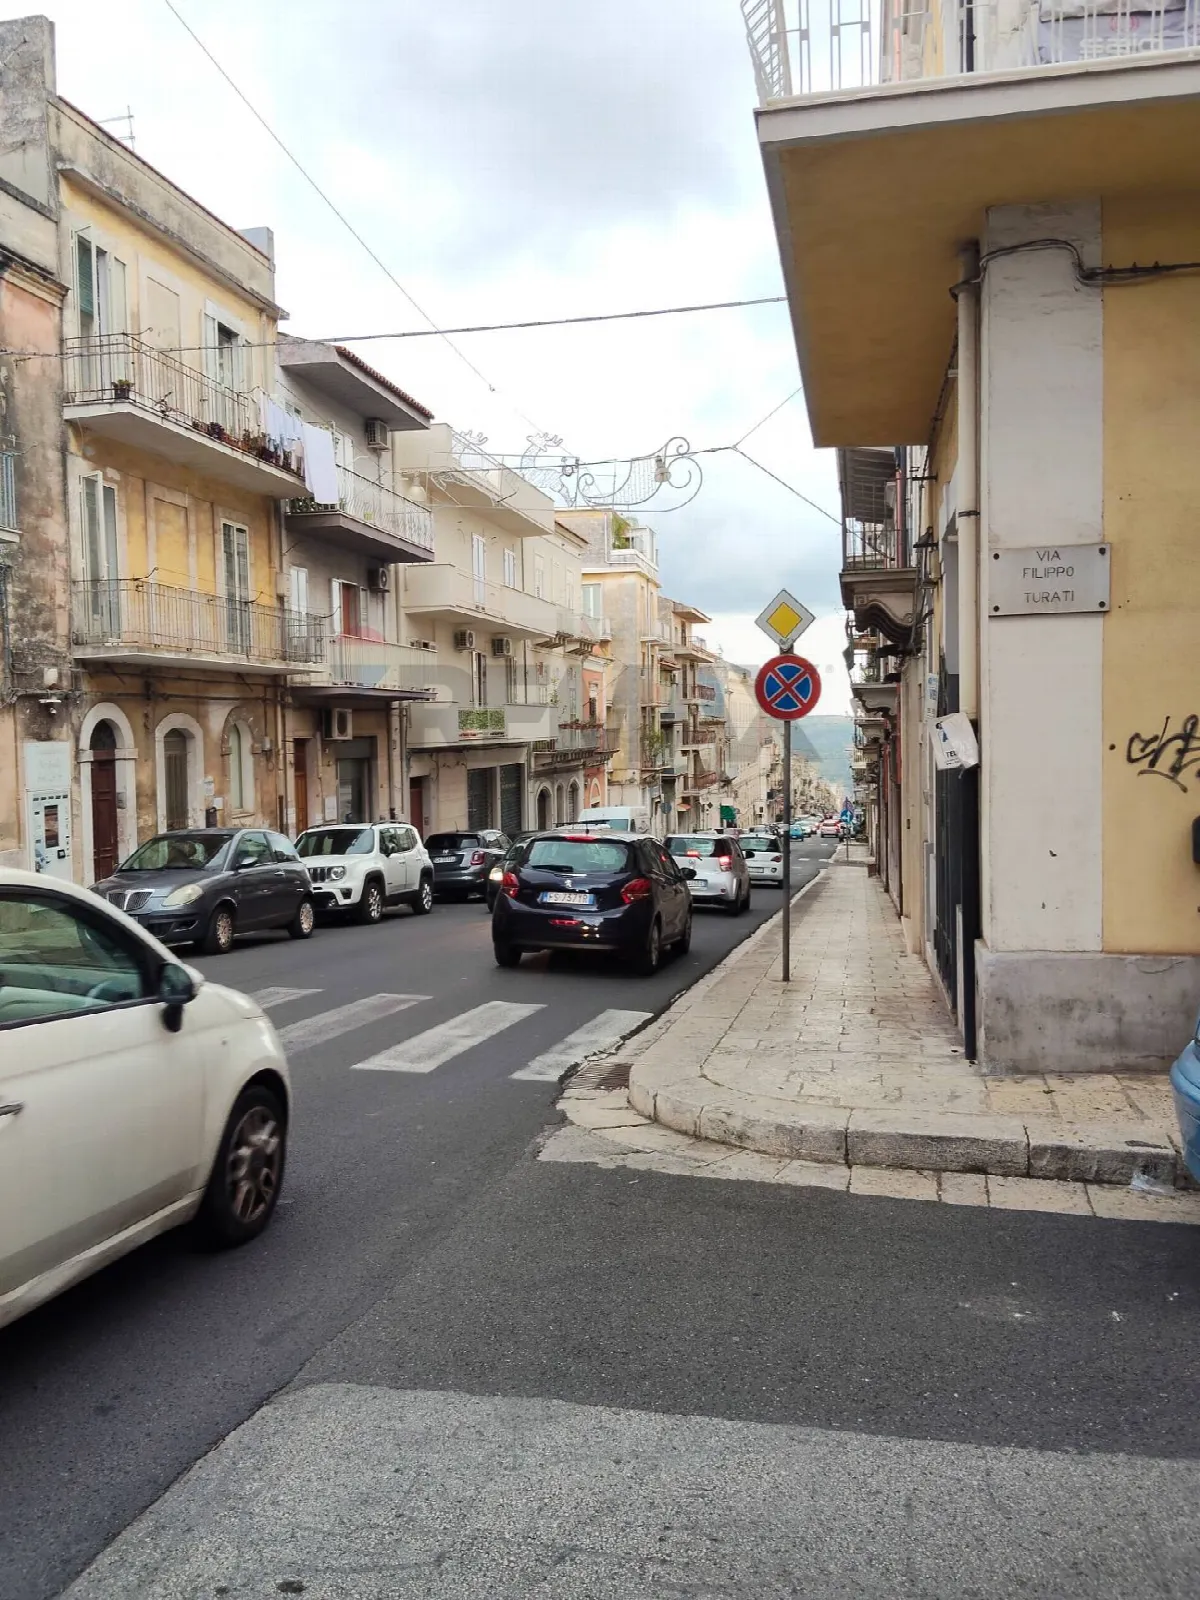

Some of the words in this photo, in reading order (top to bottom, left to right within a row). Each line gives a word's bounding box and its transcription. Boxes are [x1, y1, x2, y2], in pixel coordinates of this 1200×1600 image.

[1036, 550, 1061, 562] VIA
[1022, 566, 1075, 579] FILIPPO
[1023, 590, 1075, 603] TURATI
